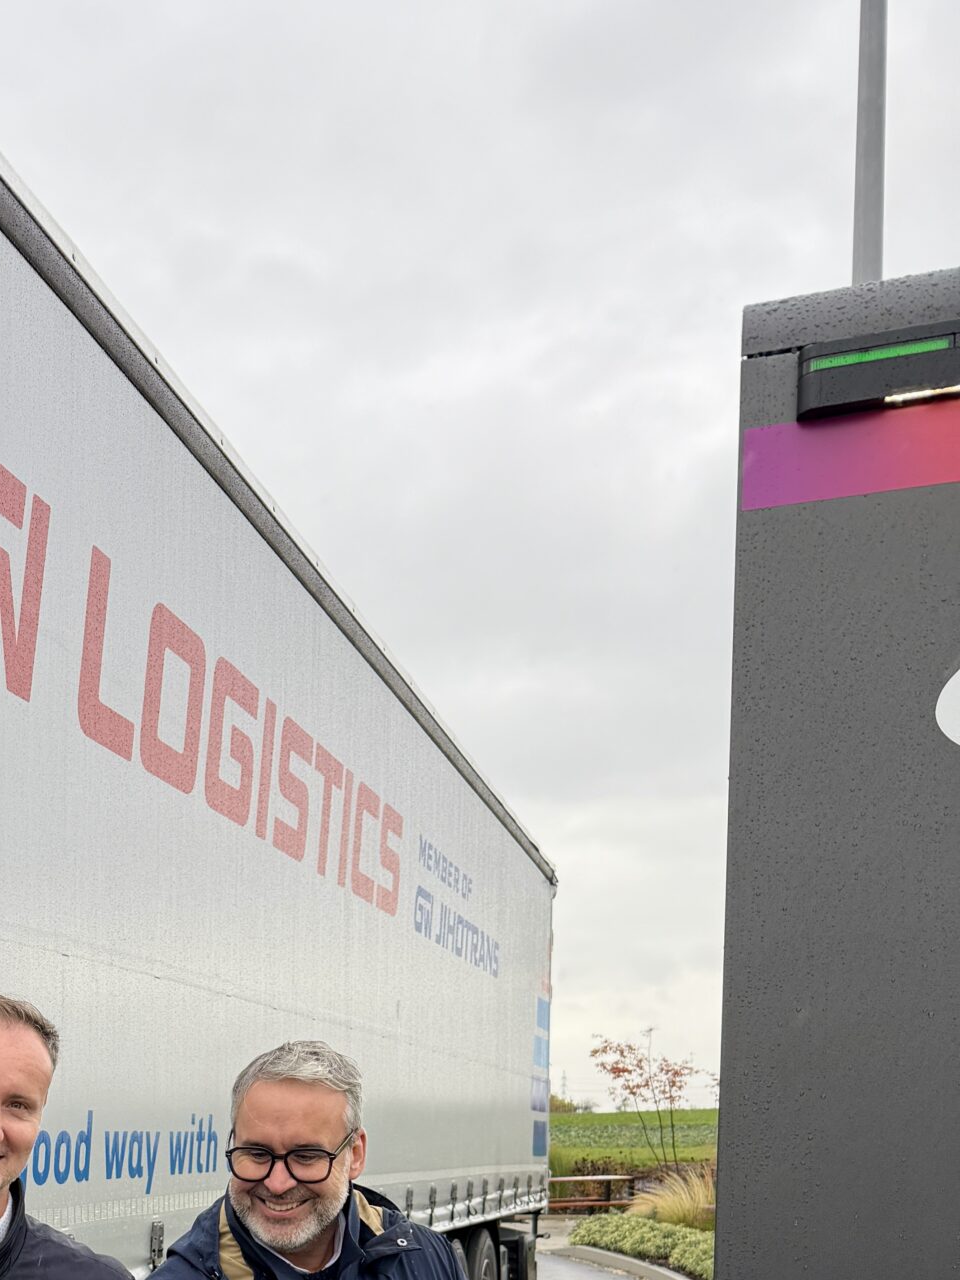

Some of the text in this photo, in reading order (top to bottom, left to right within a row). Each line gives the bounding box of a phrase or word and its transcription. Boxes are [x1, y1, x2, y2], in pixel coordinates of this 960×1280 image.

[77, 545, 404, 917] LOGISTICS
[418, 834, 473, 902] MEMBER OF
[414, 885, 500, 978] GW JIHOTRANS
[20, 1110, 93, 1193] ood
[105, 1131, 160, 1194] way
[170, 1113, 218, 1175] with
